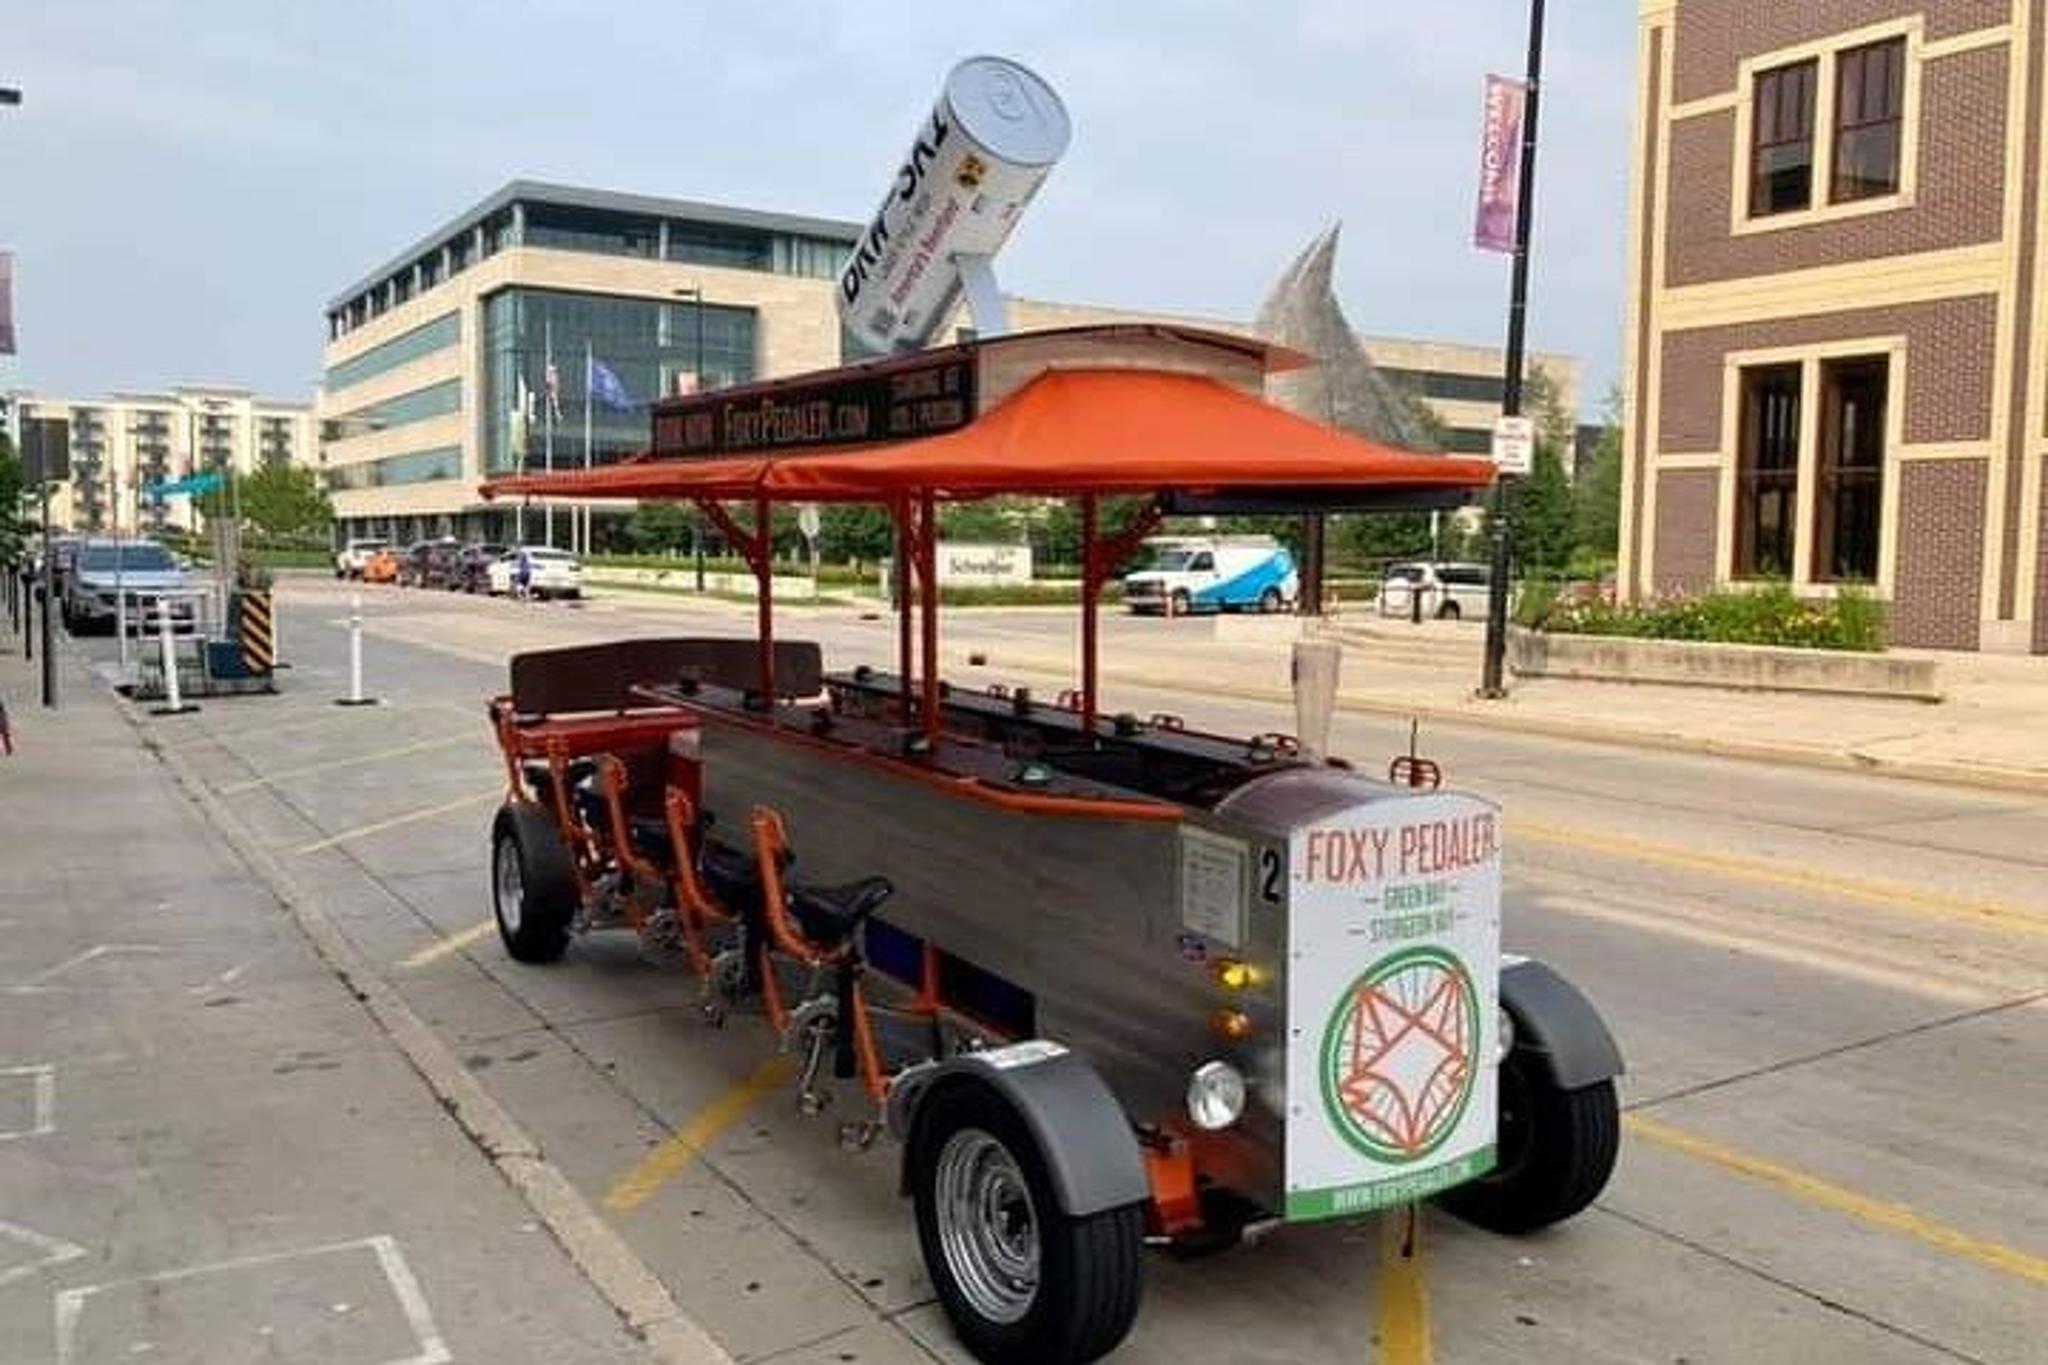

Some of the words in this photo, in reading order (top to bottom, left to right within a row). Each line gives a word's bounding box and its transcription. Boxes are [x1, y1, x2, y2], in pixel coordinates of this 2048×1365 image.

[1262, 849, 1281, 904] 2
[1308, 828, 1389, 883] FOXY
[1401, 813, 1499, 875] PEDALER
